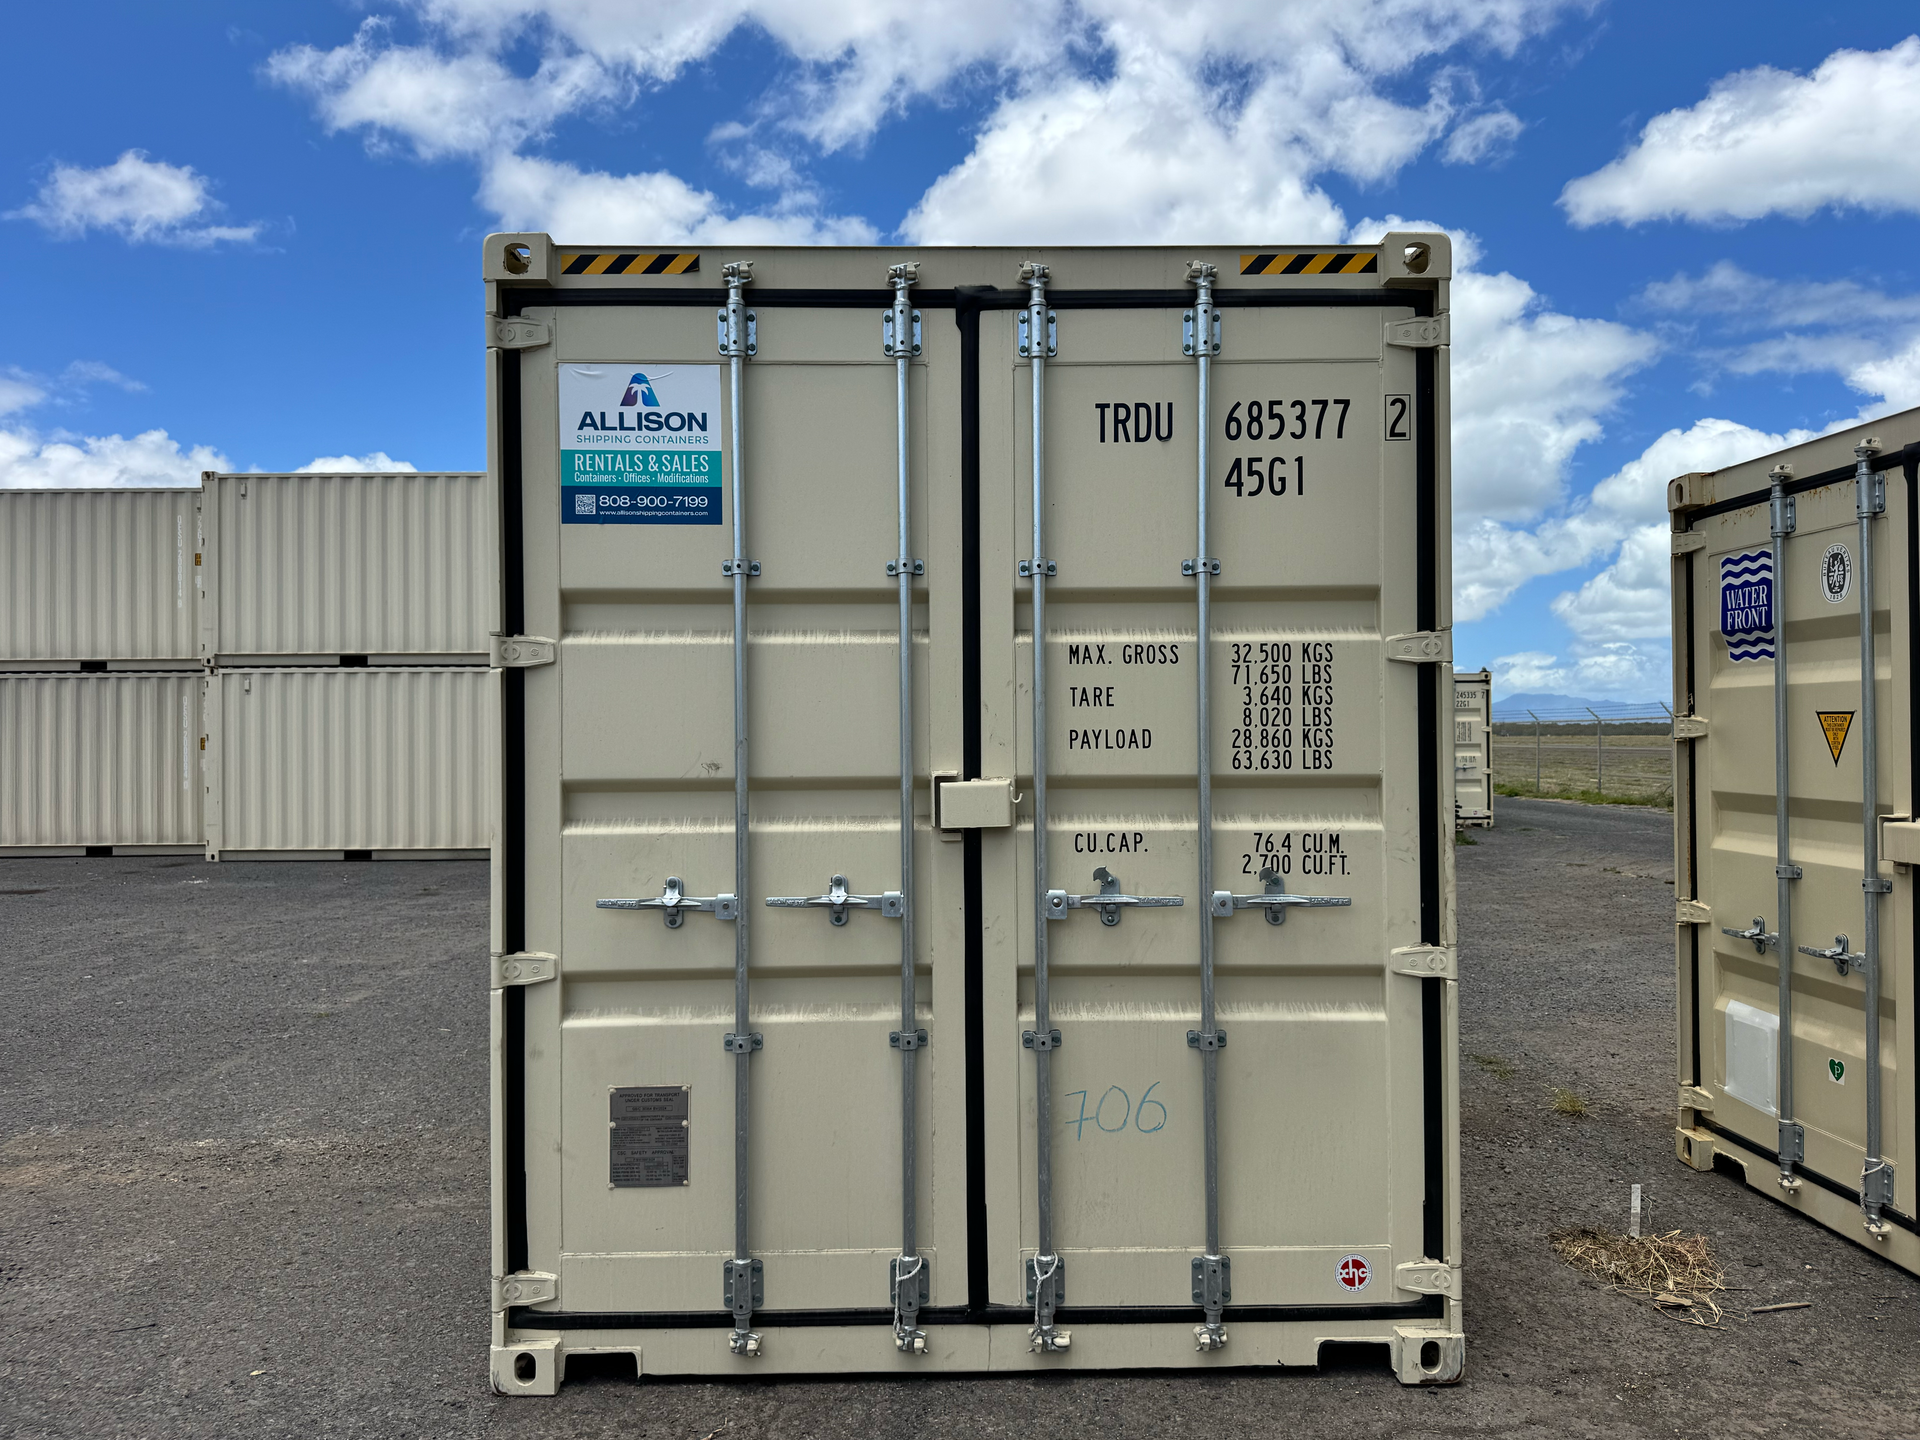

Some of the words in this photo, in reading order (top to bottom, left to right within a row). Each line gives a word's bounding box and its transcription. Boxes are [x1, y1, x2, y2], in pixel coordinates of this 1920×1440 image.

[577, 411, 708, 432] ALLISON
[1095, 402, 1173, 443] TRDU
[1225, 398, 1350, 440] 685377
[1389, 397, 1407, 438] 2
[576, 434, 632, 444] SHIPPING
[634, 435, 709, 445] CONTAINERS
[574, 453, 643, 472] RENTALS
[648, 454, 659, 472] &
[661, 454, 709, 472] SALES
[574, 472, 617, 483] Containers
[623, 472, 651, 483] Offices
[657, 472, 709, 484] Modifications
[1224, 455, 1304, 497] 45G1
[599, 495, 708, 508] 808-900-7199
[599, 509, 709, 517] www.allisonshippingcontainers.com
[1726, 584, 1768, 610] WATER
[1726, 606, 1768, 631] FRONT
[1068, 644, 1113, 665] MAX.
[1122, 644, 1180, 665] GROSS
[1231, 643, 1292, 664] 32,500
[1301, 642, 1334, 663] KGS
[1231, 664, 1292, 685] 71,650
[1301, 664, 1333, 685] LBS
[1069, 686, 1115, 707] TARE
[1242, 685, 1292, 707] 3,640
[1301, 685, 1334, 706] KGS
[1456, 700, 1470, 708] 22G1
[1242, 707, 1292, 728] 8,020
[1301, 707, 1333, 727] LBS
[1824, 715, 1848, 723] ATTENTION
[1069, 729, 1153, 749] PAYLOAD
[1231, 728, 1292, 750] 28,860
[1301, 728, 1334, 748] KGS
[1231, 750, 1292, 771] 63,630
[1301, 749, 1333, 770] LBS
[1074, 832, 1149, 853] CU.CAP.
[1253, 832, 1292, 853] 76.4
[1302, 833, 1345, 854] CU.M.
[1242, 853, 1292, 875] 2,700
[1302, 854, 1351, 875] CU.FT.
[1065, 1081, 1167, 1141] 706
